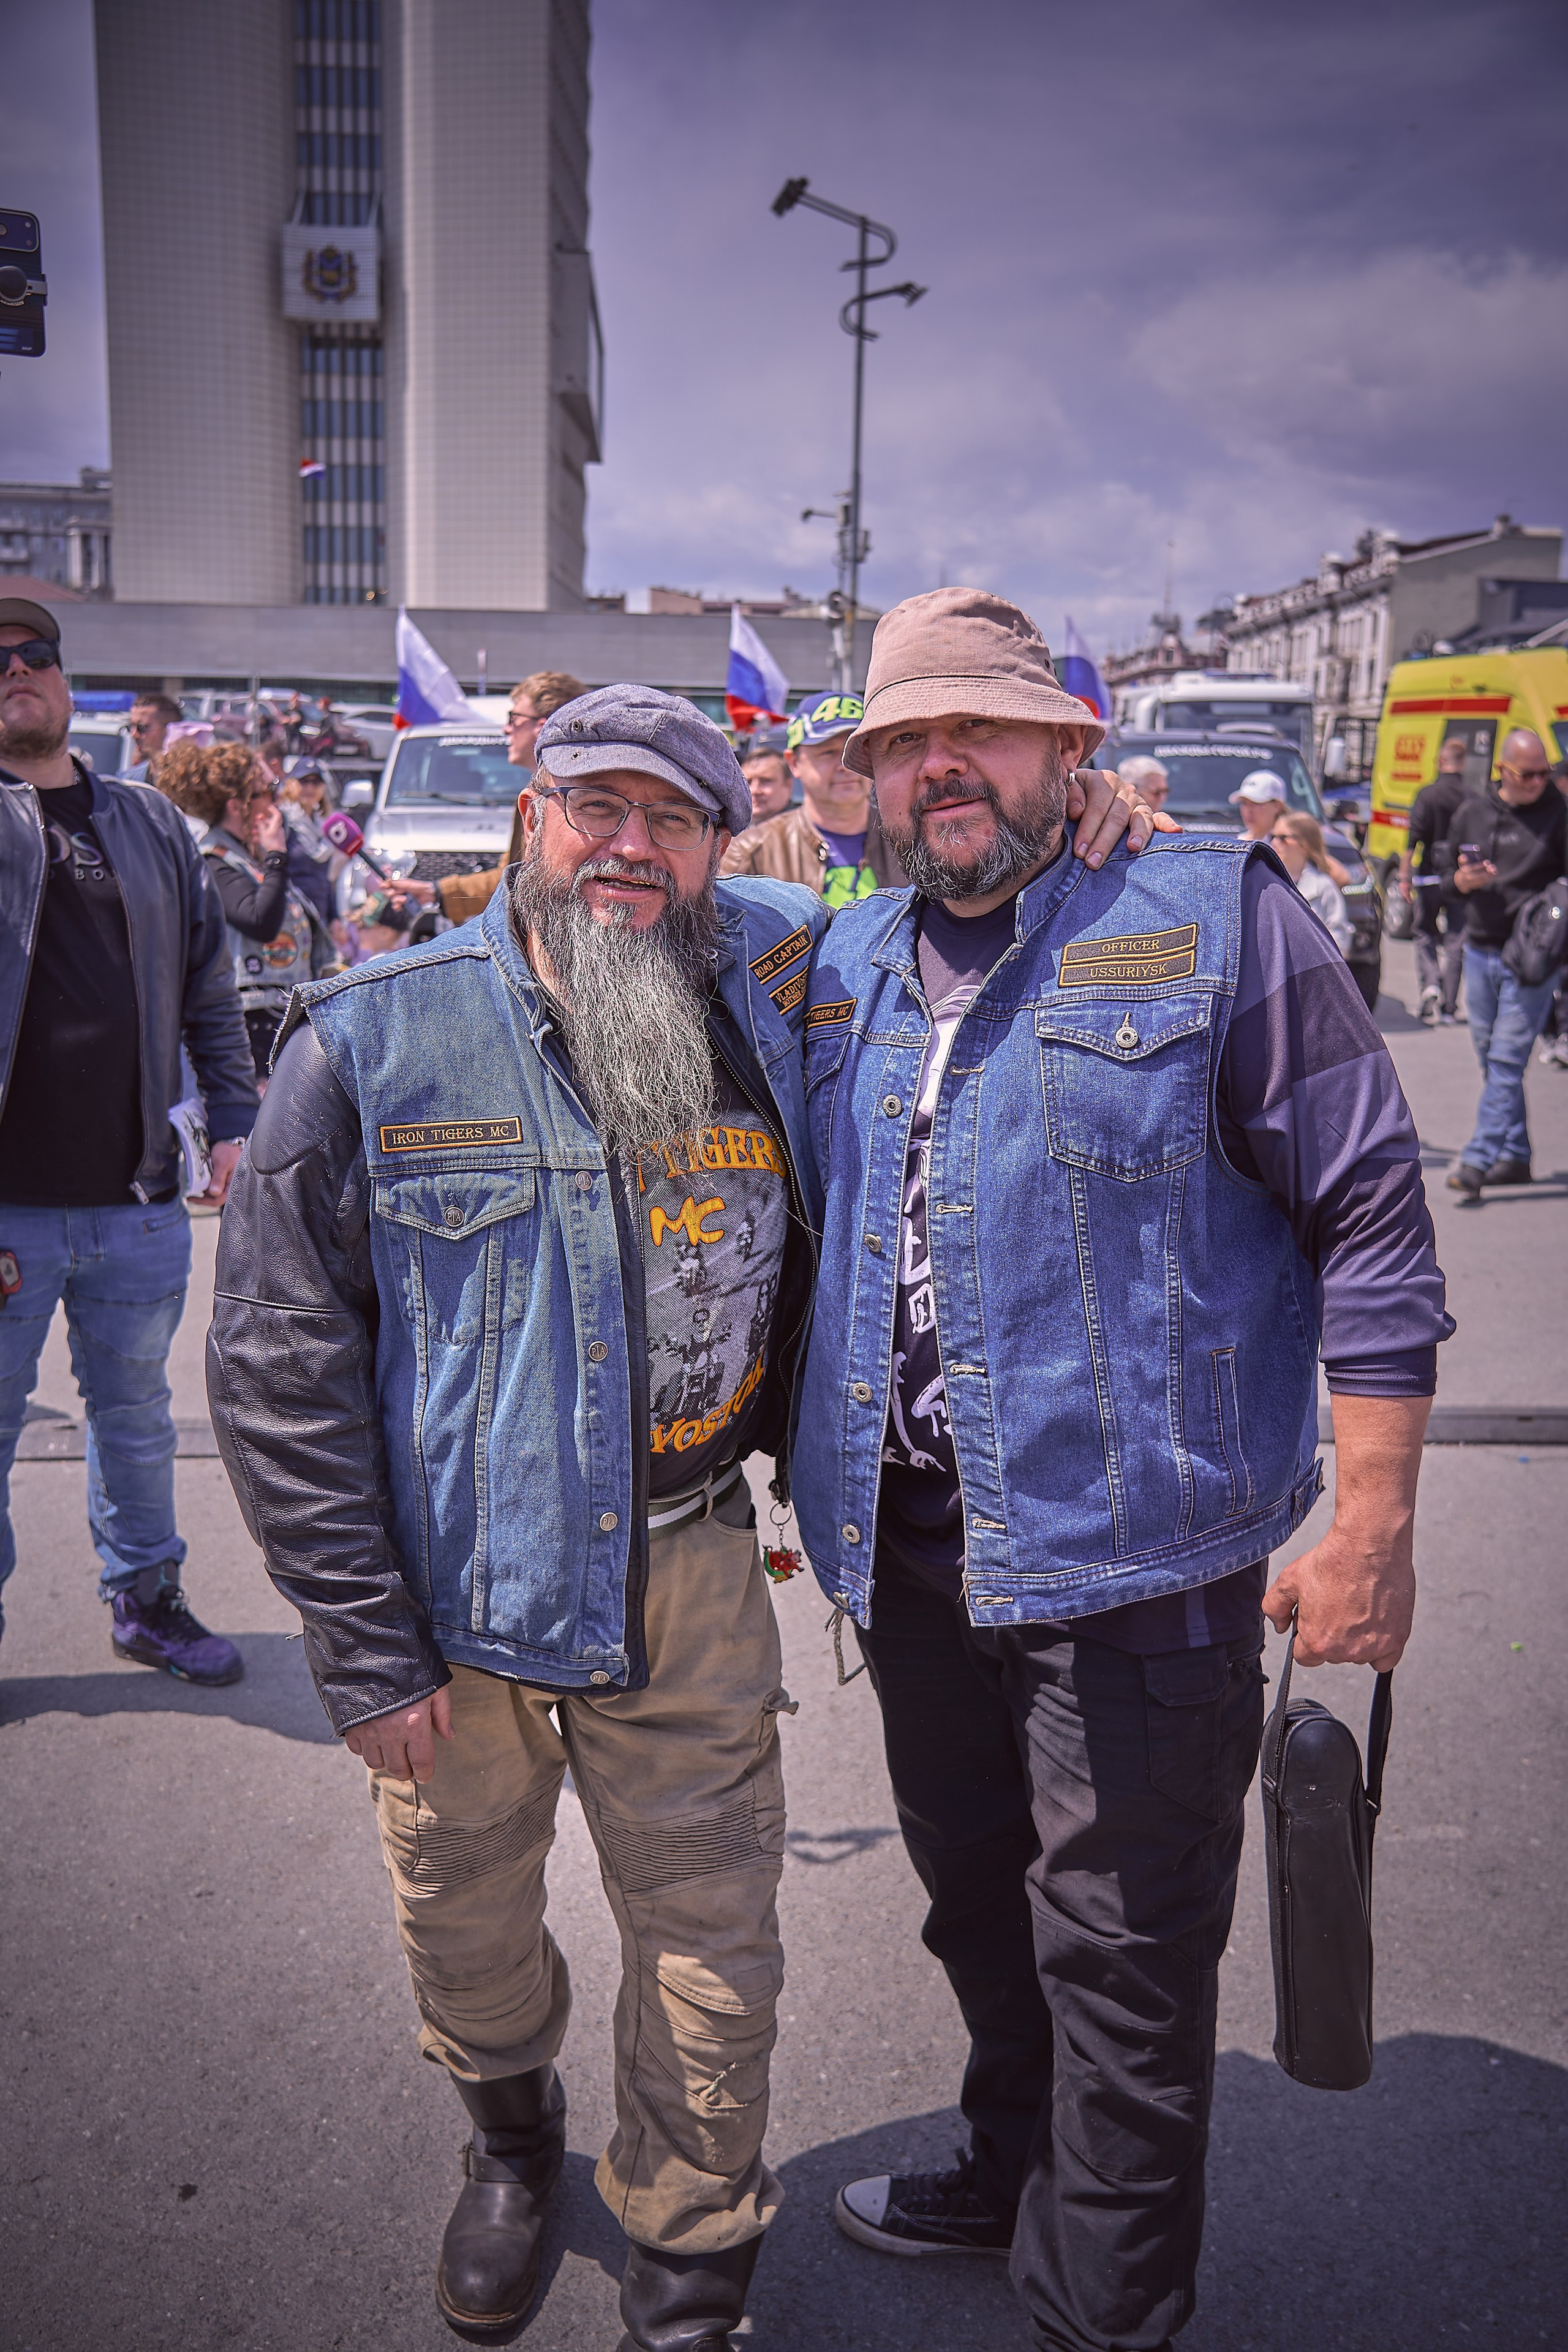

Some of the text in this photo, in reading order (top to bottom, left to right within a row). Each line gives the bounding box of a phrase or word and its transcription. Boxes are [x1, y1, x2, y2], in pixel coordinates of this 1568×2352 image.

[810, 696, 864, 723] 46
[74, 868, 104, 880] BO
[1102, 939, 1159, 952] OFFICER
[753, 935, 809, 978] ROAD CAPTAIN
[1090, 963, 1167, 978] USSURIYSK
[810, 1006, 850, 1022] TIGERS MC
[392, 1125, 510, 1145] IRON TIGERS MC
[649, 1196, 725, 1246] MC
